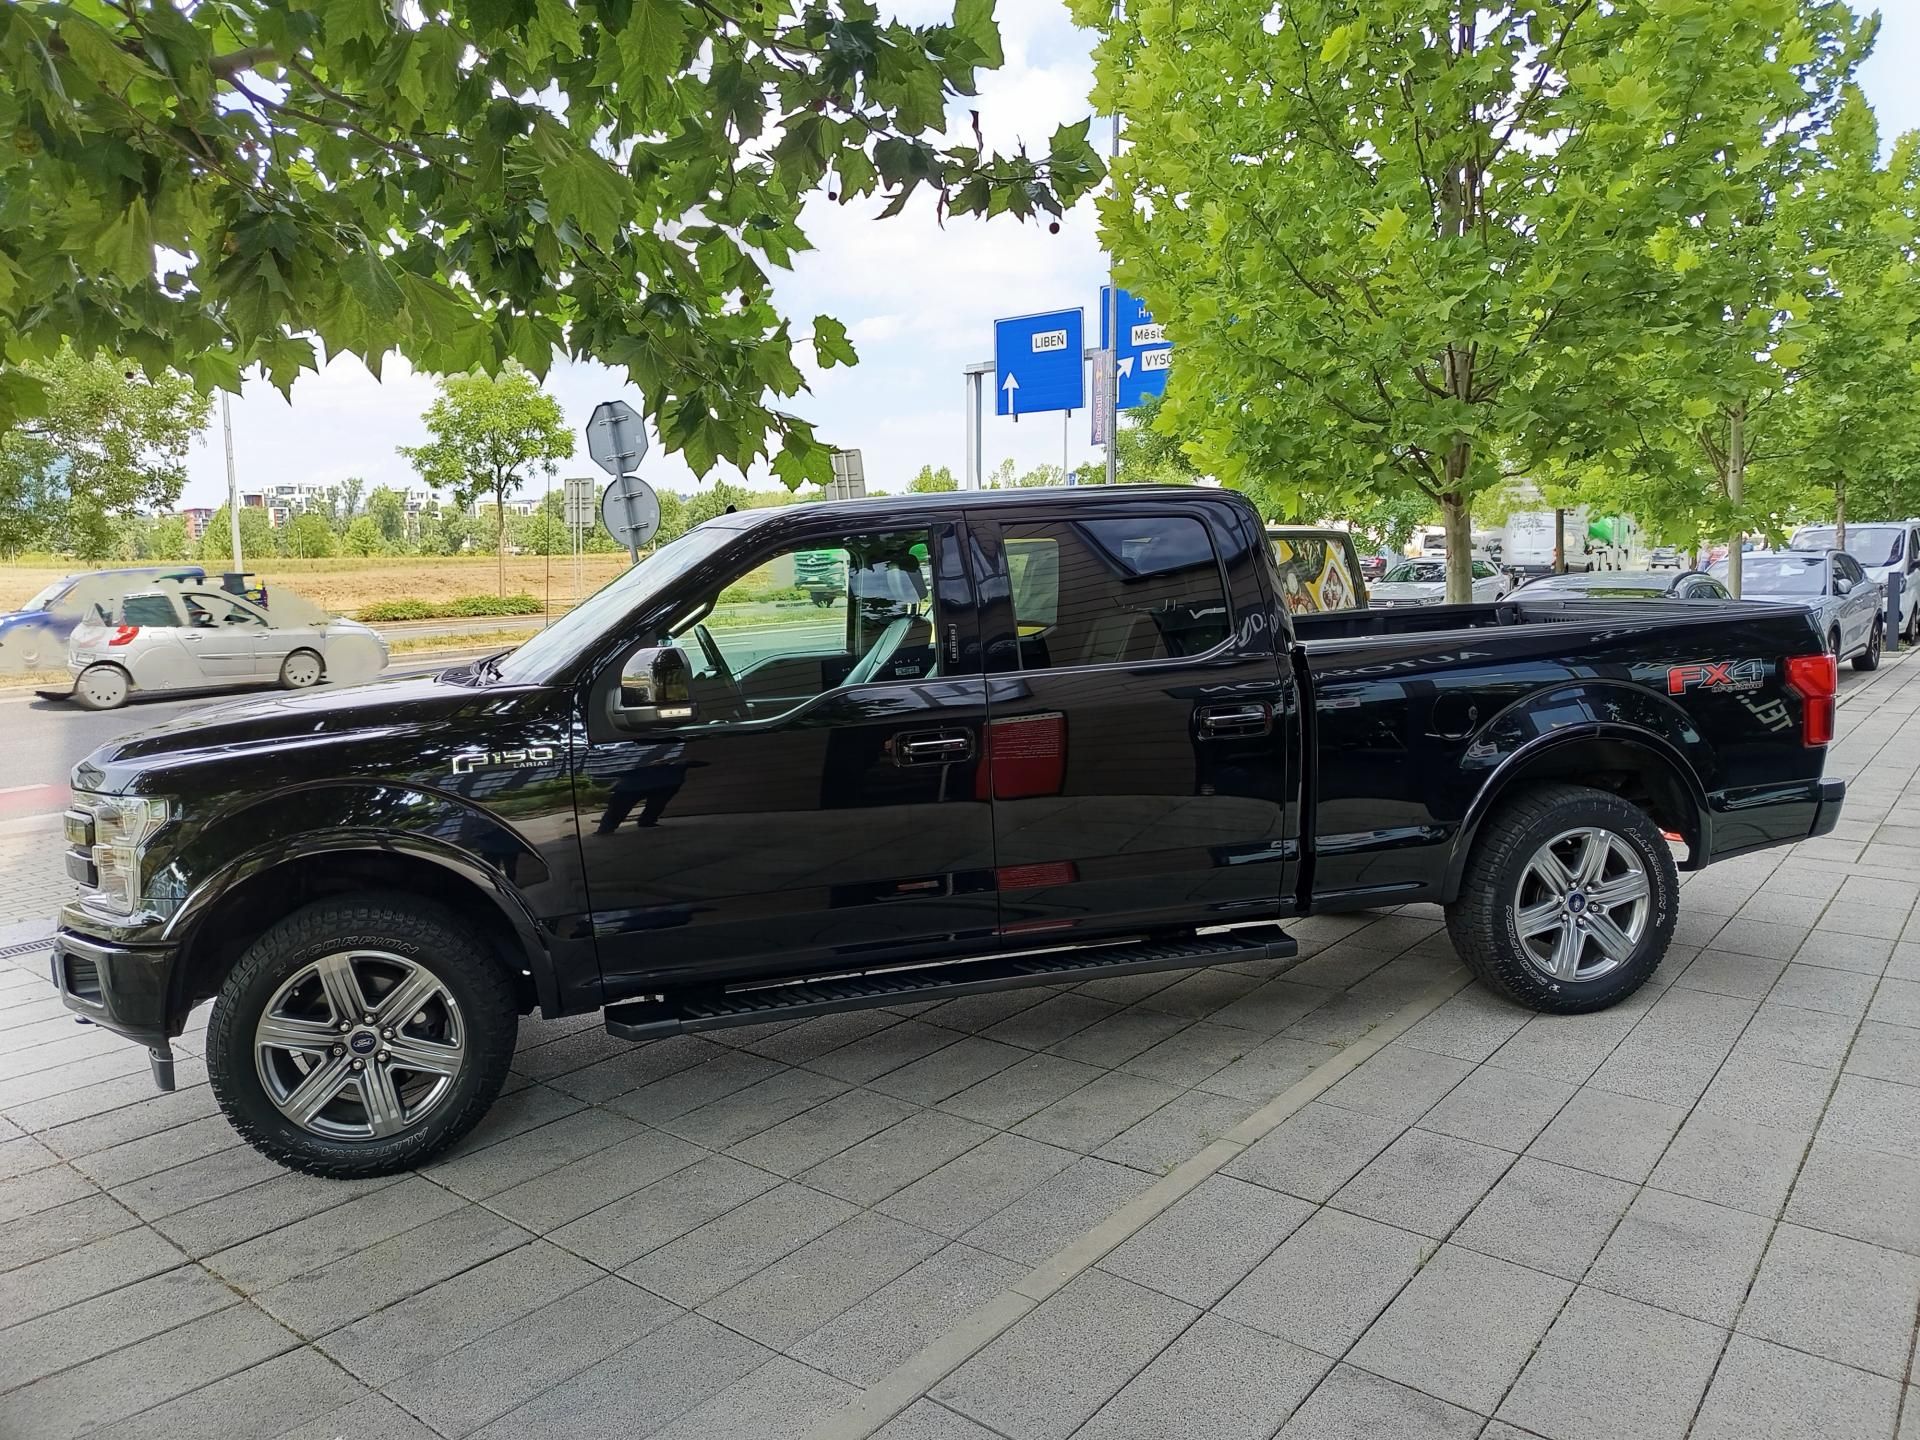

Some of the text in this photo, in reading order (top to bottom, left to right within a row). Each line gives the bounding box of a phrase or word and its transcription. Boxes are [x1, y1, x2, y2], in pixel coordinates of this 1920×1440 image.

[1034, 331, 1064, 349] LIBEŇ
[1667, 658, 1765, 696] FX4
[513, 760, 549, 769] LARIAT
